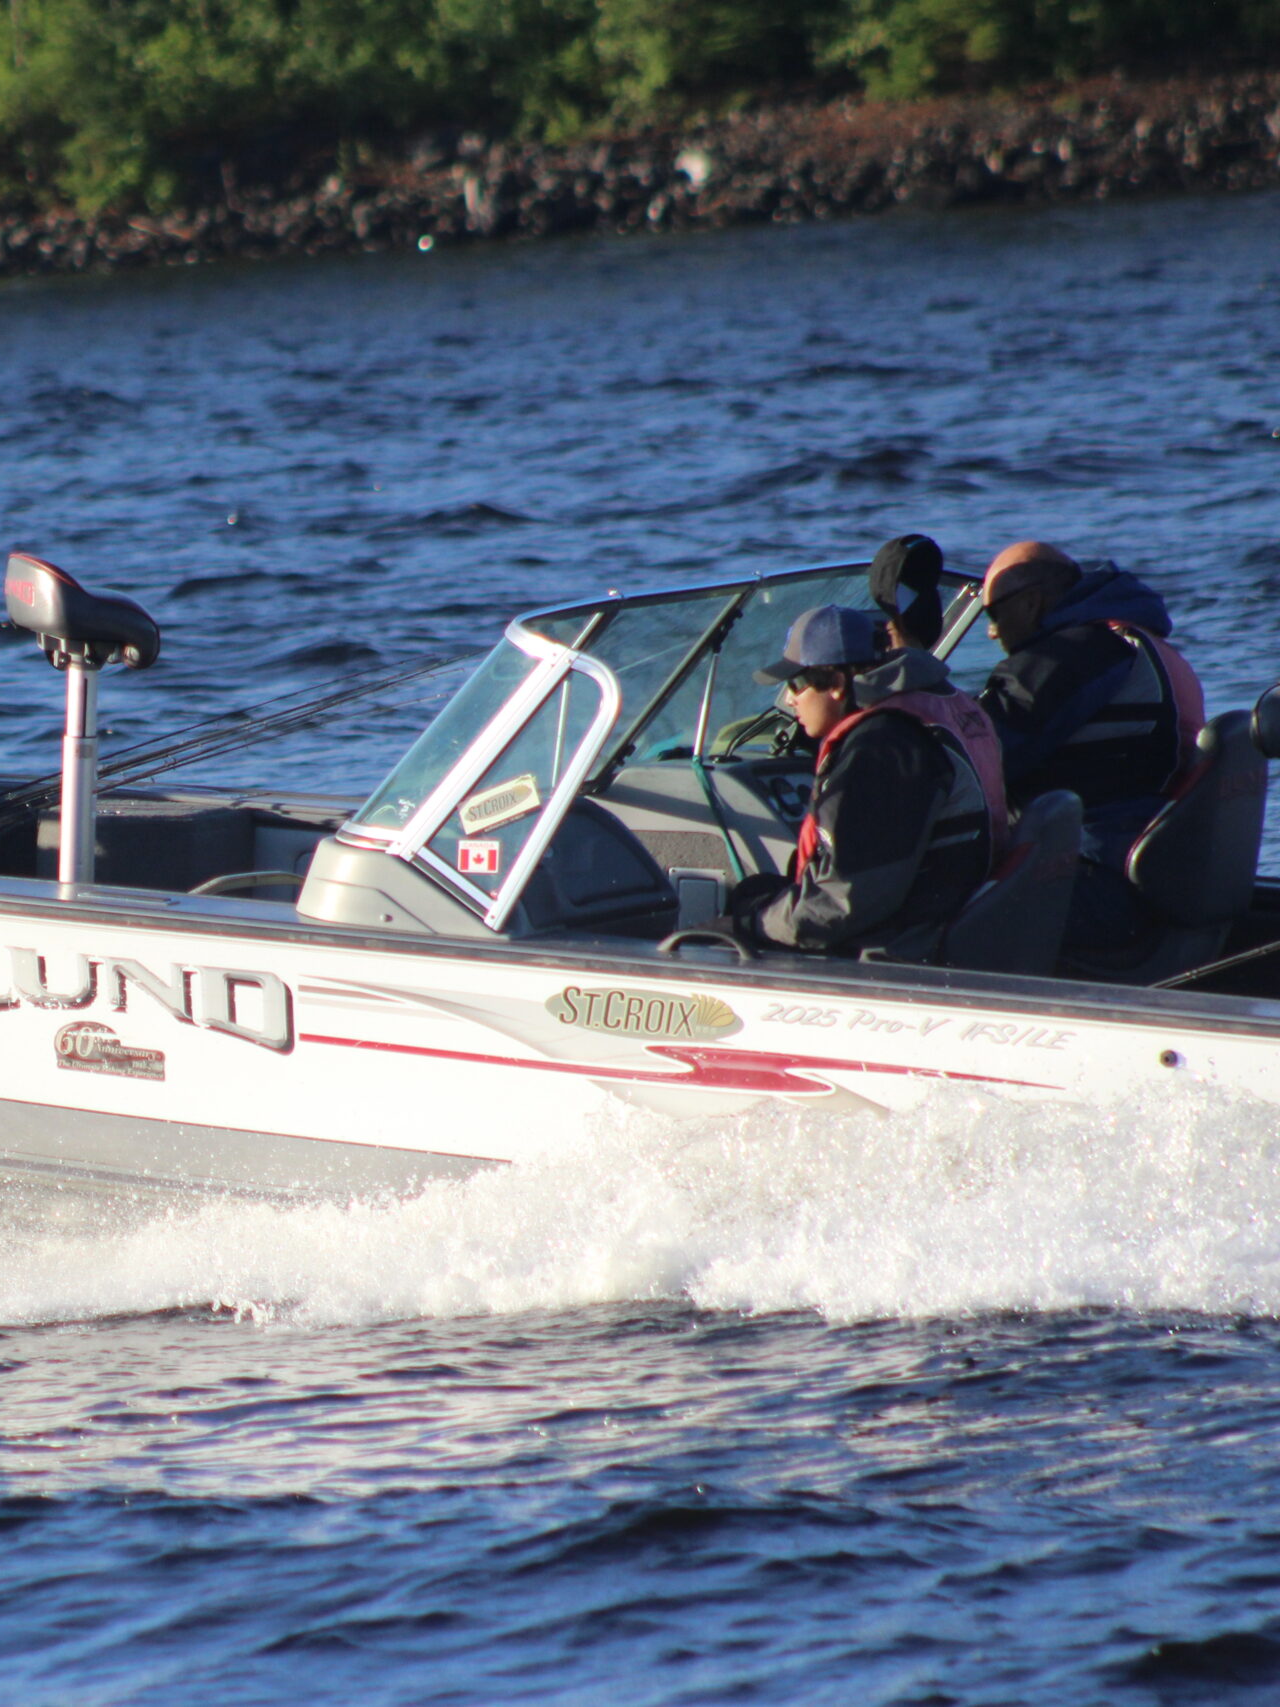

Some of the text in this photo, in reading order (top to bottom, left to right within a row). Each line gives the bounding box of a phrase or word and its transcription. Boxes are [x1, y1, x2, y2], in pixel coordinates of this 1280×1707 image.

[761, 1002, 1077, 1050] 2025 Pro-V IFS/LE
